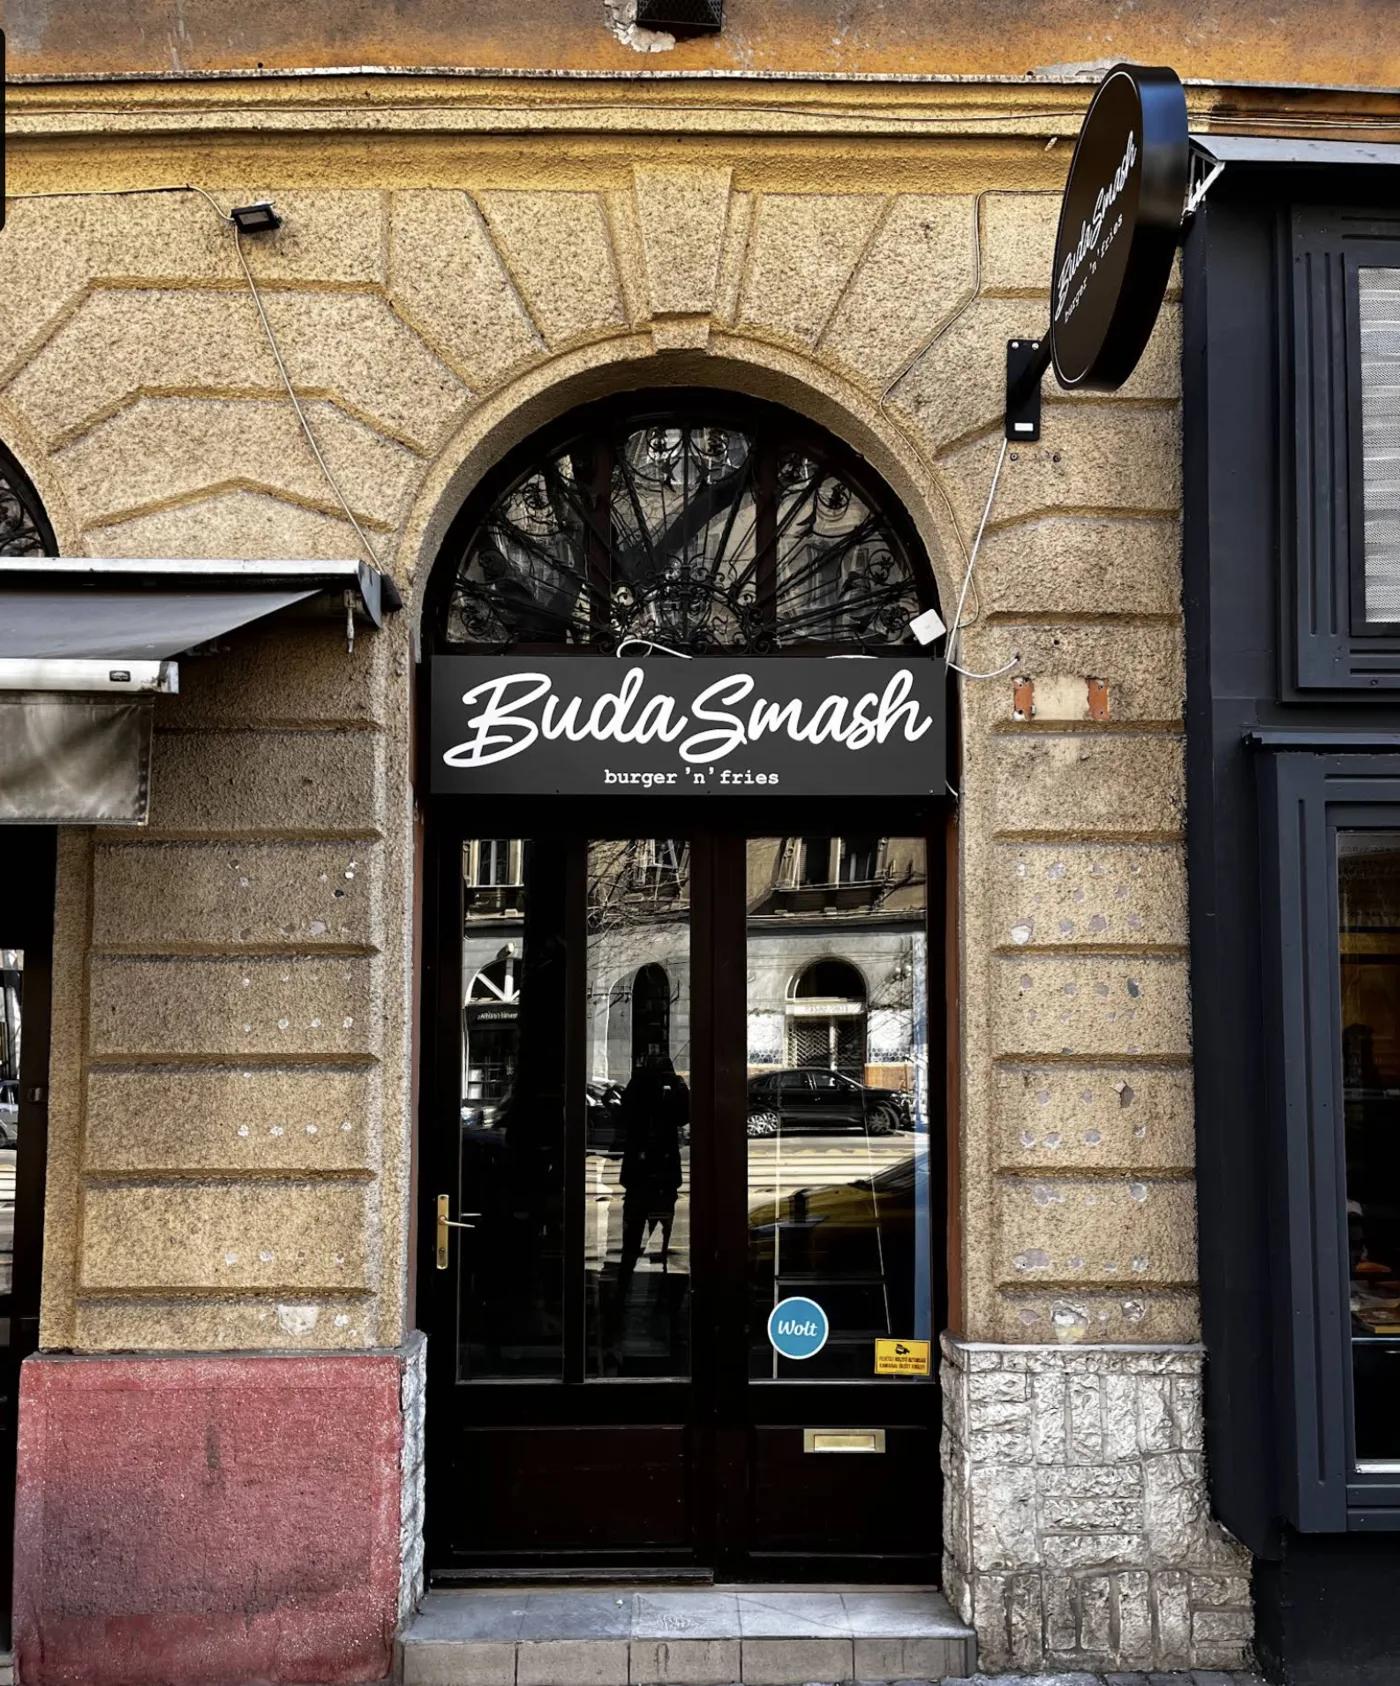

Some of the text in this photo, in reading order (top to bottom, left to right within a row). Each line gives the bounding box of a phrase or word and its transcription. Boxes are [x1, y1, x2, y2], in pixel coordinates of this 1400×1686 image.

[1064, 276, 1088, 324] burger
[604, 768, 677, 789] burger
[719, 769, 780, 785] fries
[777, 1320, 818, 1337] Wolt
